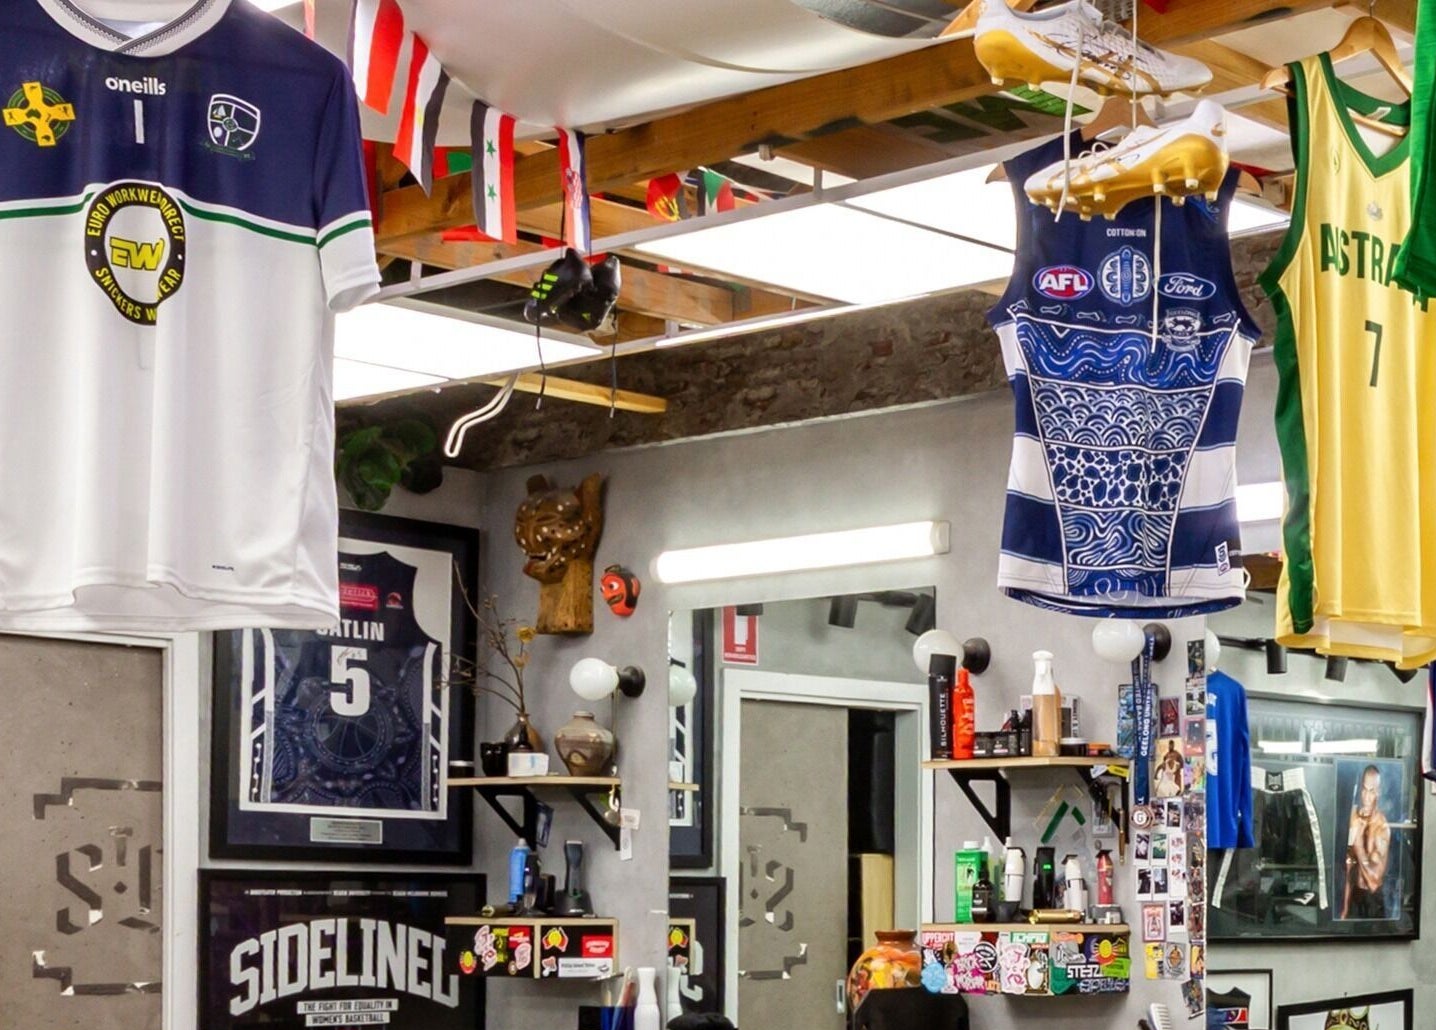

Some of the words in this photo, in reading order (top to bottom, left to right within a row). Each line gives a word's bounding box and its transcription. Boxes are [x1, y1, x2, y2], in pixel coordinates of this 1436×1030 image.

[87, 202, 109, 237] EURO
[160, 198, 186, 240] DIRECT
[95, 266, 142, 320] SNICKERS
[1039, 270, 1089, 291] AFL
[1164, 276, 1205, 297] Ford
[1365, 320, 1382, 387] 7
[329, 645, 371, 717] 5
[939, 693, 947, 746] SILHOUETTE
[1141, 718, 1150, 757] GEELONG
[312, 1015, 342, 1024] WOMEN'S
[345, 1013, 384, 1022] BASKETBALL
[318, 1002, 336, 1010] FIGHT
[354, 1001, 383, 1010] EQUALITY
